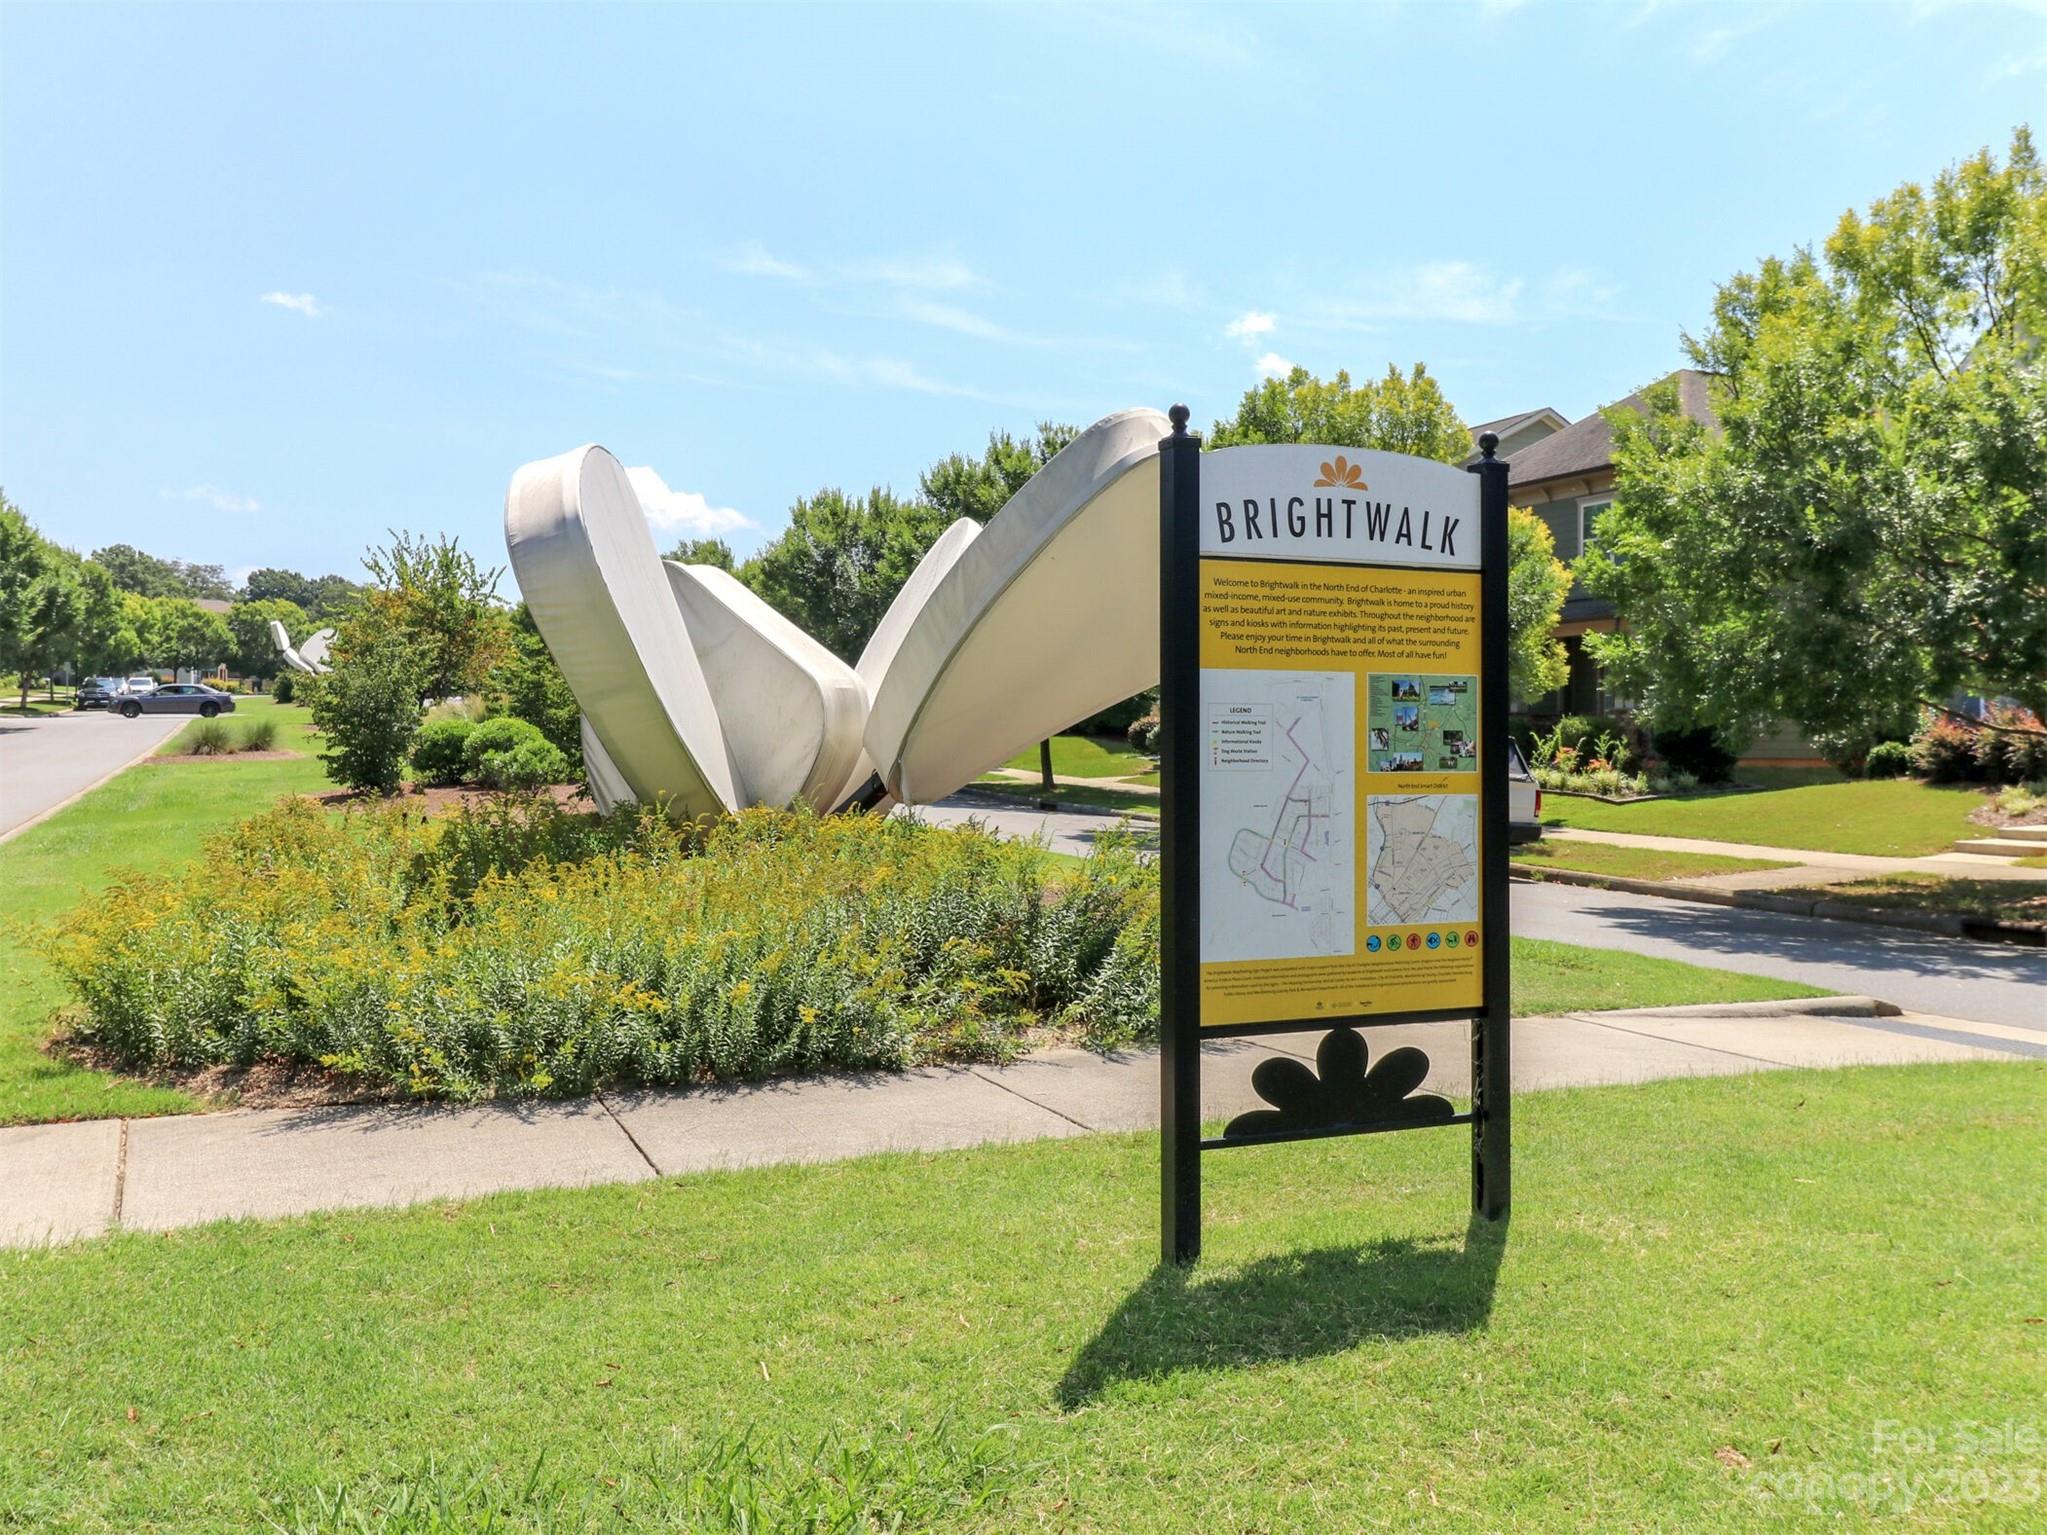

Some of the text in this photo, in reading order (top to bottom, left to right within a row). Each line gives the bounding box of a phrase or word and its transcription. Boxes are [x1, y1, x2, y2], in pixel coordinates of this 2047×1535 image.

[1216, 496, 1460, 556] BRIGHTWALK
[1214, 578, 1249, 587] Welcome
[1260, 581, 1299, 590] Brightwalk
[1361, 585, 1369, 593] of
[1369, 586, 1402, 594] Charlotte
[1204, 591, 1261, 601] mixed-income,
[1262, 594, 1301, 602] mixed-use
[1302, 597, 1344, 606] community.
[1347, 597, 1385, 607] Brightwalk
[1429, 601, 1449, 610] proud
[1451, 602, 1474, 612] history
[1240, 606, 1274, 614] beautiful
[1360, 611, 1401, 621] Throughout
[1416, 613, 1463, 622] neighborhood
[1209, 620, 1229, 628] signs
[1247, 619, 1269, 628] kiosks
[1289, 621, 1332, 629] information
[1334, 623, 1376, 633] highlighting
[1433, 626, 1445, 634] and
[1447, 626, 1469, 635] future.
[1220, 631, 1244, 640] Please
[1246, 633, 1266, 644] enjoy
[1267, 635, 1284, 644] your
[1286, 633, 1302, 642] time
[1313, 635, 1351, 645] Brightwalk
[1419, 639, 1460, 649] surrounding
[1259, 646, 1273, 654] End
[1275, 647, 1329, 657] neighborhoods
[1331, 648, 1348, 656] have
[1358, 649, 1375, 657] offer.
[1397, 650, 1404, 658] of
[1415, 650, 1431, 658] have
[1433, 650, 1447, 659] fun!
